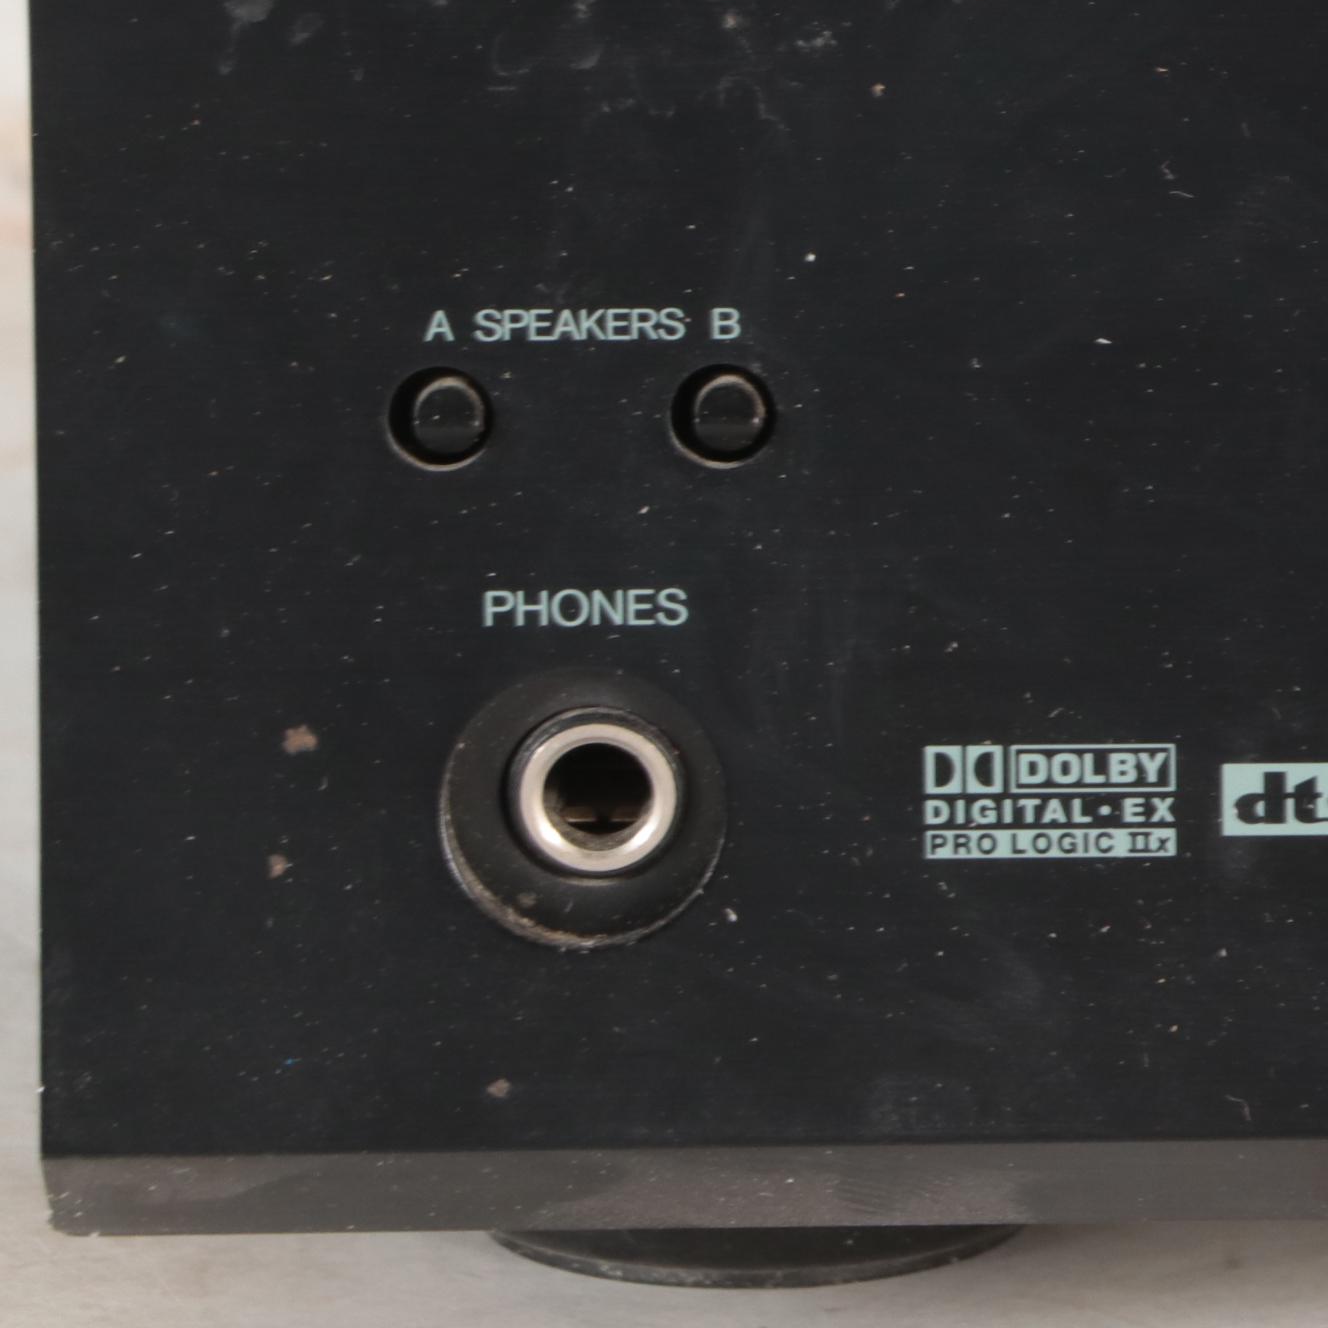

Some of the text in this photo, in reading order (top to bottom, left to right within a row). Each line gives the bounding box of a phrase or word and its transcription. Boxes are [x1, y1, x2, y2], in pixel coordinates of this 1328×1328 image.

[425, 307, 741, 342] A SPEAKERS B
[484, 587, 689, 627] PHONES
[1017, 752, 1168, 785] DOLBY
[929, 832, 998, 856] PRO
[1011, 832, 1114, 855] LOGIC
